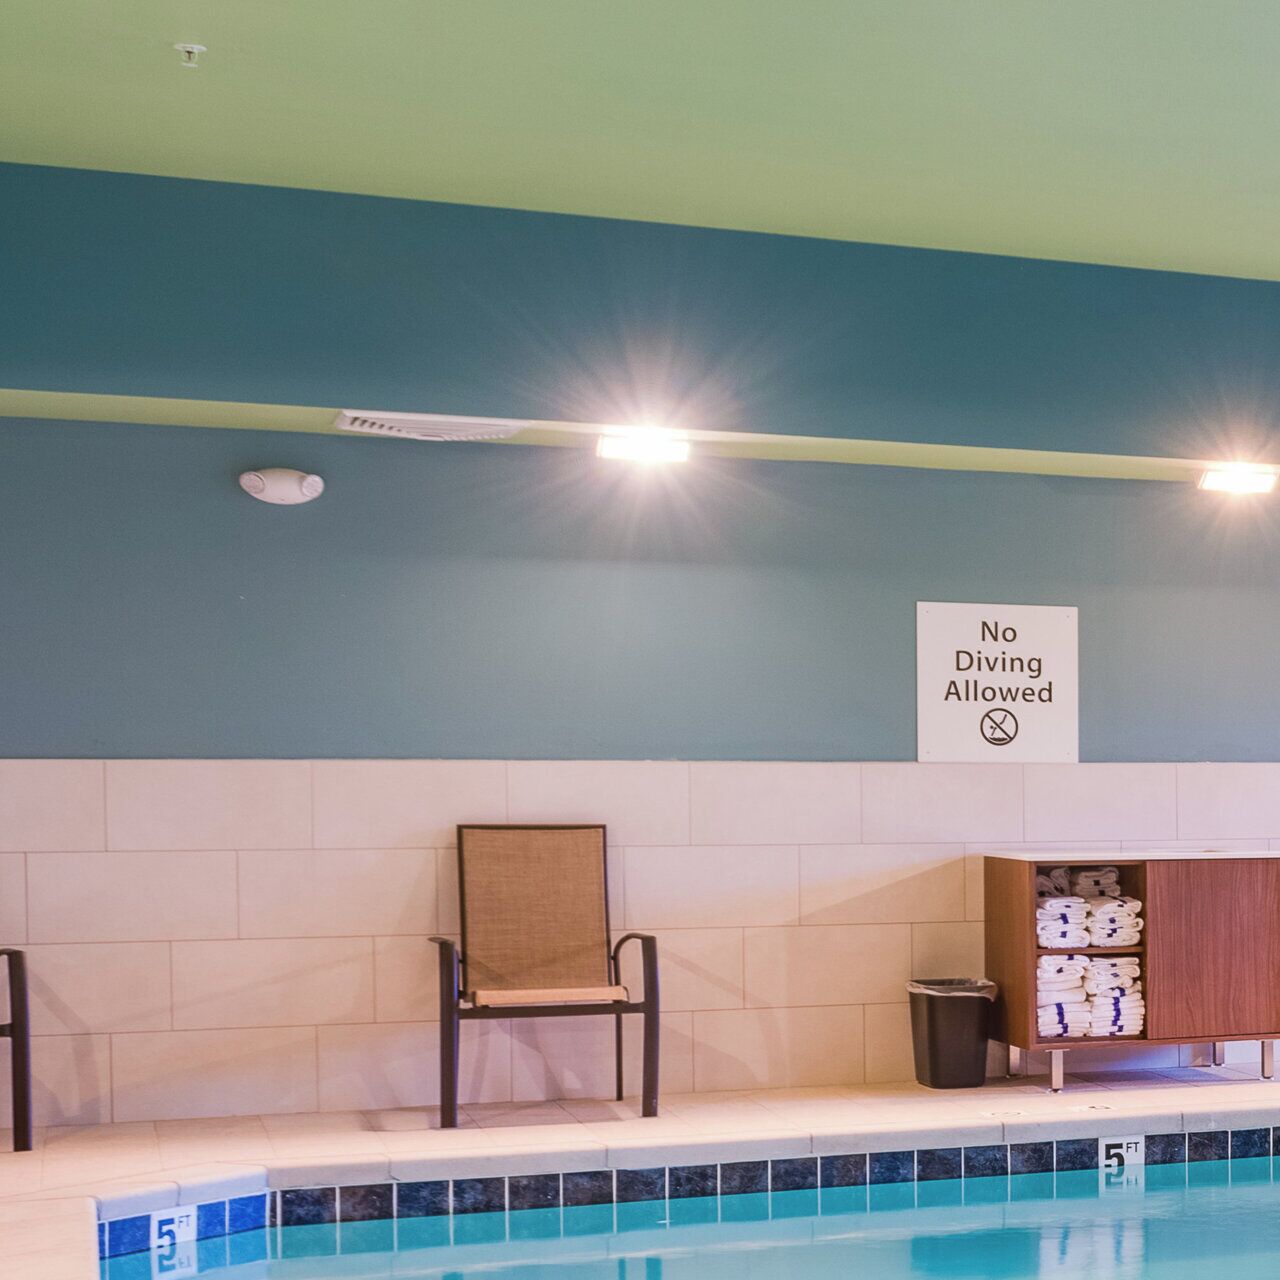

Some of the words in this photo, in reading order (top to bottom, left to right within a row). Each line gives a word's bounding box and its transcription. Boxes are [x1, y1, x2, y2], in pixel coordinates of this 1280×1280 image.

[981, 620, 1017, 643] No
[955, 650, 1042, 679] Diving
[944, 679, 1053, 703] Allowed
[1104, 1142, 1125, 1168] 5
[157, 1217, 176, 1248] 5
